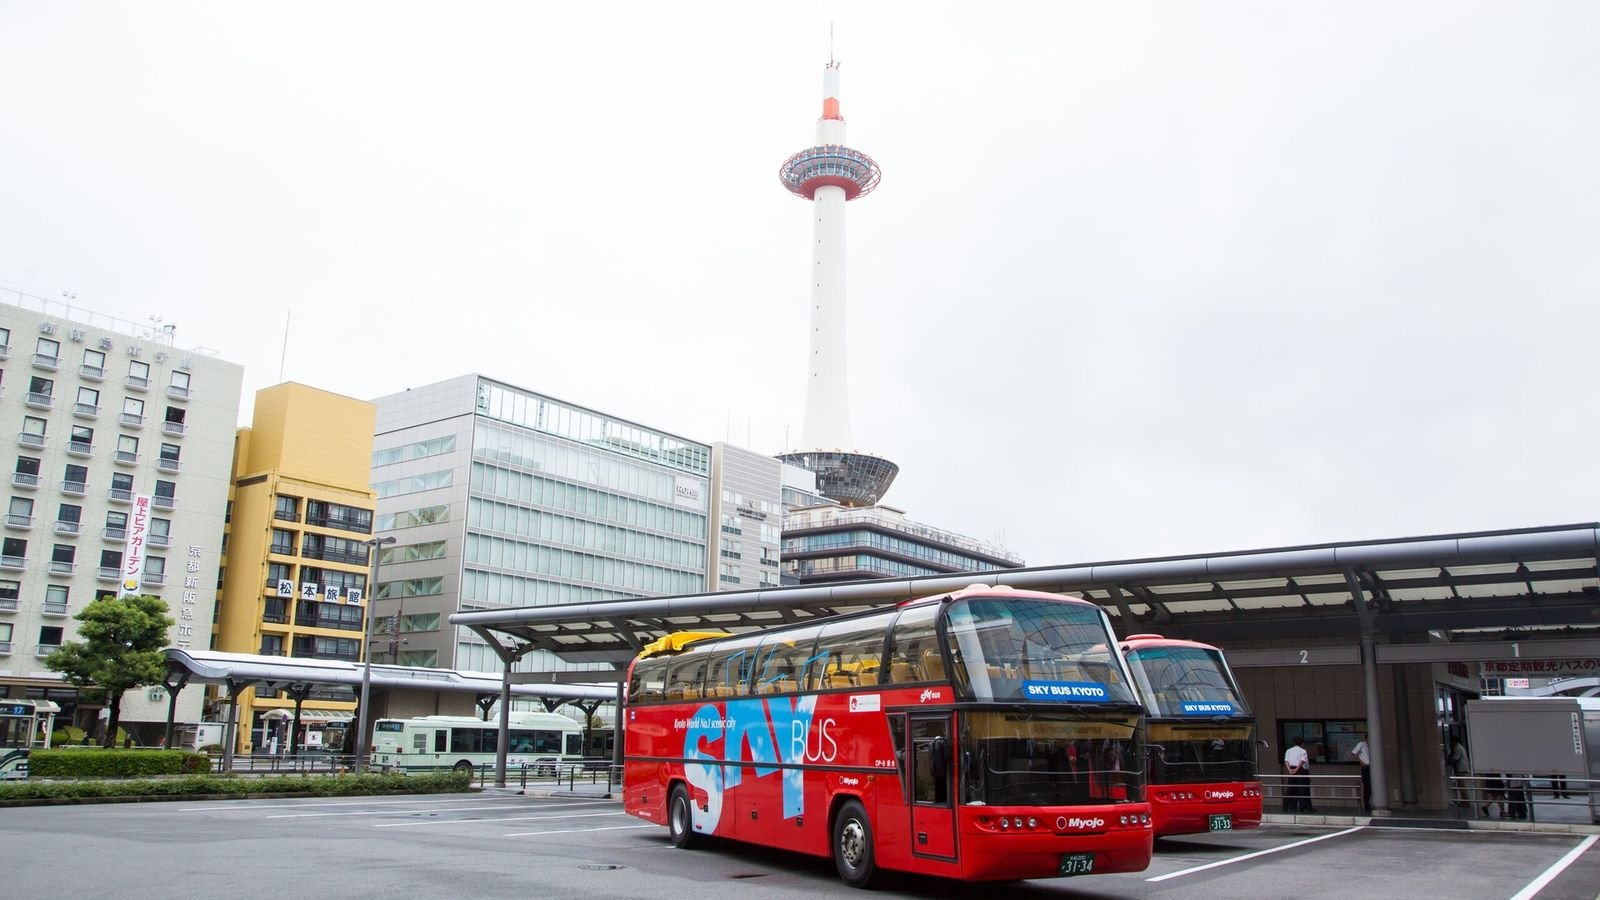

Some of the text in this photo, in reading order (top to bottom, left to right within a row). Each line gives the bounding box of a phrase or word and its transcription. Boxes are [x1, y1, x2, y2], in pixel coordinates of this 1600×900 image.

[127, 497, 149, 575] 屋上ビアガーデン
[279, 582, 360, 602] 松本旅館
[1300, 650, 1308, 663] 2
[1511, 643, 1519, 657] 1
[1028, 685, 1104, 697] SKY BUS KYOTO
[674, 718, 686, 732] Kyoto
[686, 717, 700, 728] World
[711, 716, 726, 728] scenic
[726, 716, 737, 731] city
[792, 718, 837, 762] BUS
[843, 776, 859, 785] Myojo
[1211, 791, 1234, 799] Myojo
[1068, 818, 1105, 829] Myojo
